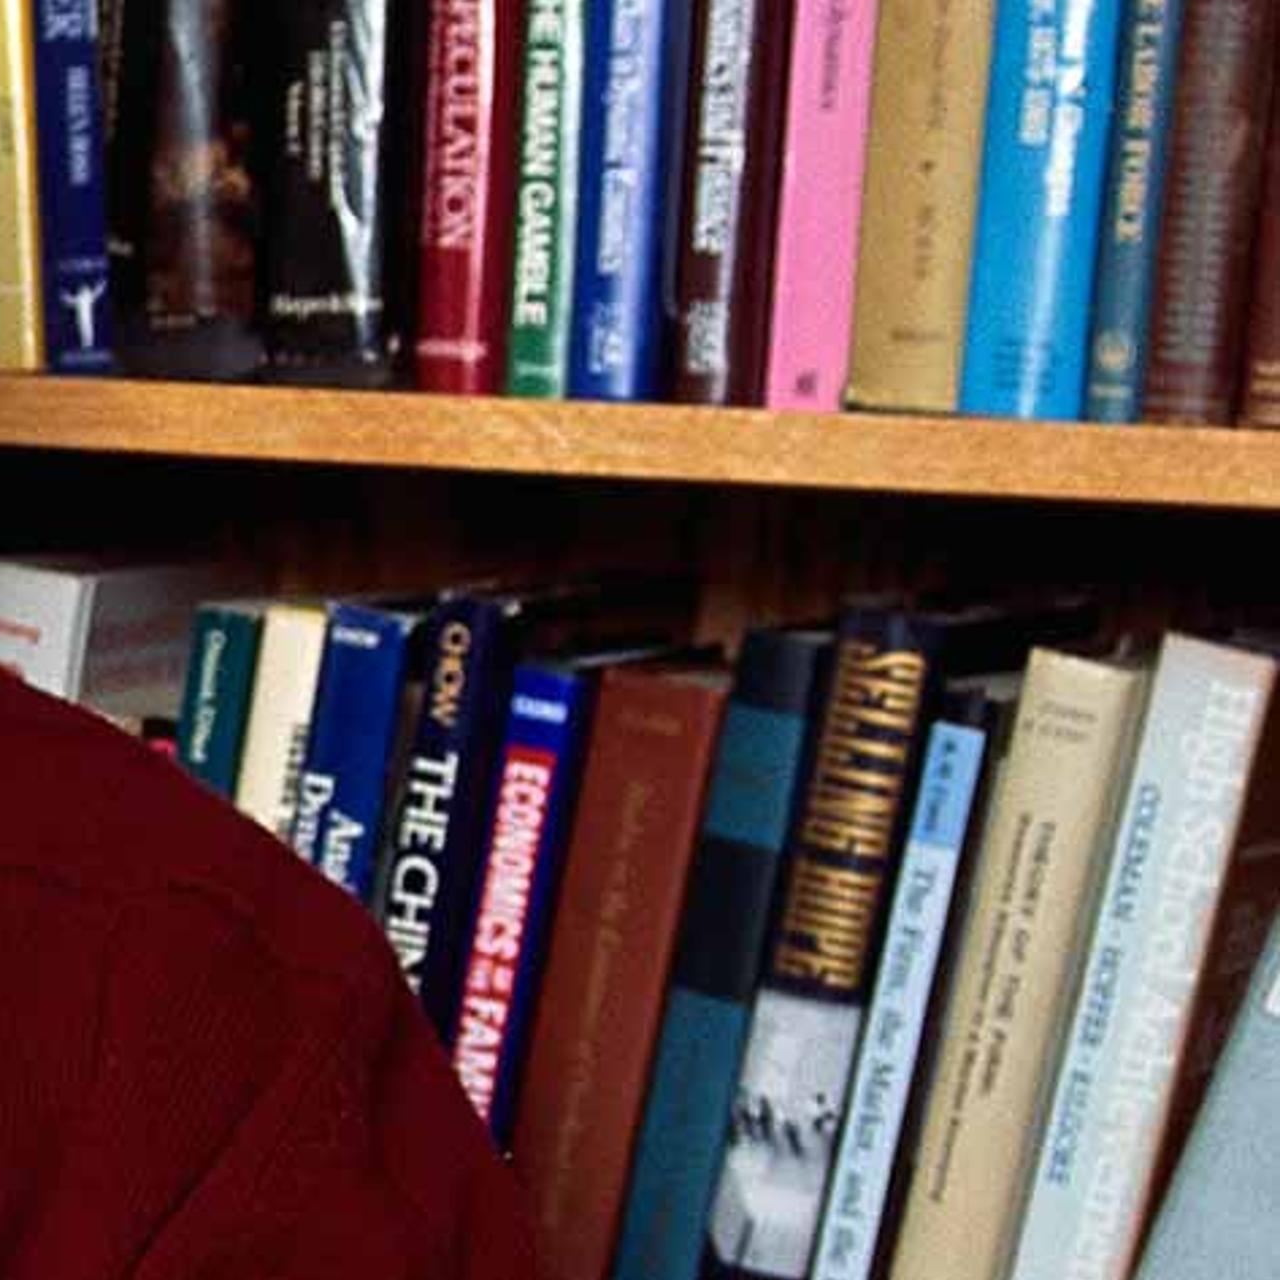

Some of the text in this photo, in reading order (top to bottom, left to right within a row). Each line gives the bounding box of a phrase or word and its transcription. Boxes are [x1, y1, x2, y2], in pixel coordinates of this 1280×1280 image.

[521, 49, 562, 176] HUMAN
[1126, 18, 1163, 134] LABOR
[691, 145, 746, 254] Finance
[1114, 140, 1152, 244] FORCE
[515, 181, 553, 327] GAMBLE
[430, 620, 472, 728] CHOW
[1181, 677, 1261, 804] High
[324, 807, 366, 896] Ana
[475, 761, 551, 959] ECONOMICS
[773, 641, 929, 995] SELLING HOPE
[1022, 821, 1058, 916] THEORY
[385, 751, 460, 996] THE CHIN
[905, 865, 938, 916] The
[1146, 818, 1227, 984] School
[883, 925, 926, 998] Firm,
[996, 975, 1024, 1022] THE
[1011, 928, 1033, 963] OF
[1046, 784, 1160, 1187] COLEMAN HOFFER KILGORE
[453, 995, 510, 1120] FAM
[877, 1006, 908, 1048] the
[853, 1060, 895, 1158] Market,
[828, 1227, 857, 1268] the
[838, 1169, 868, 1220] and
